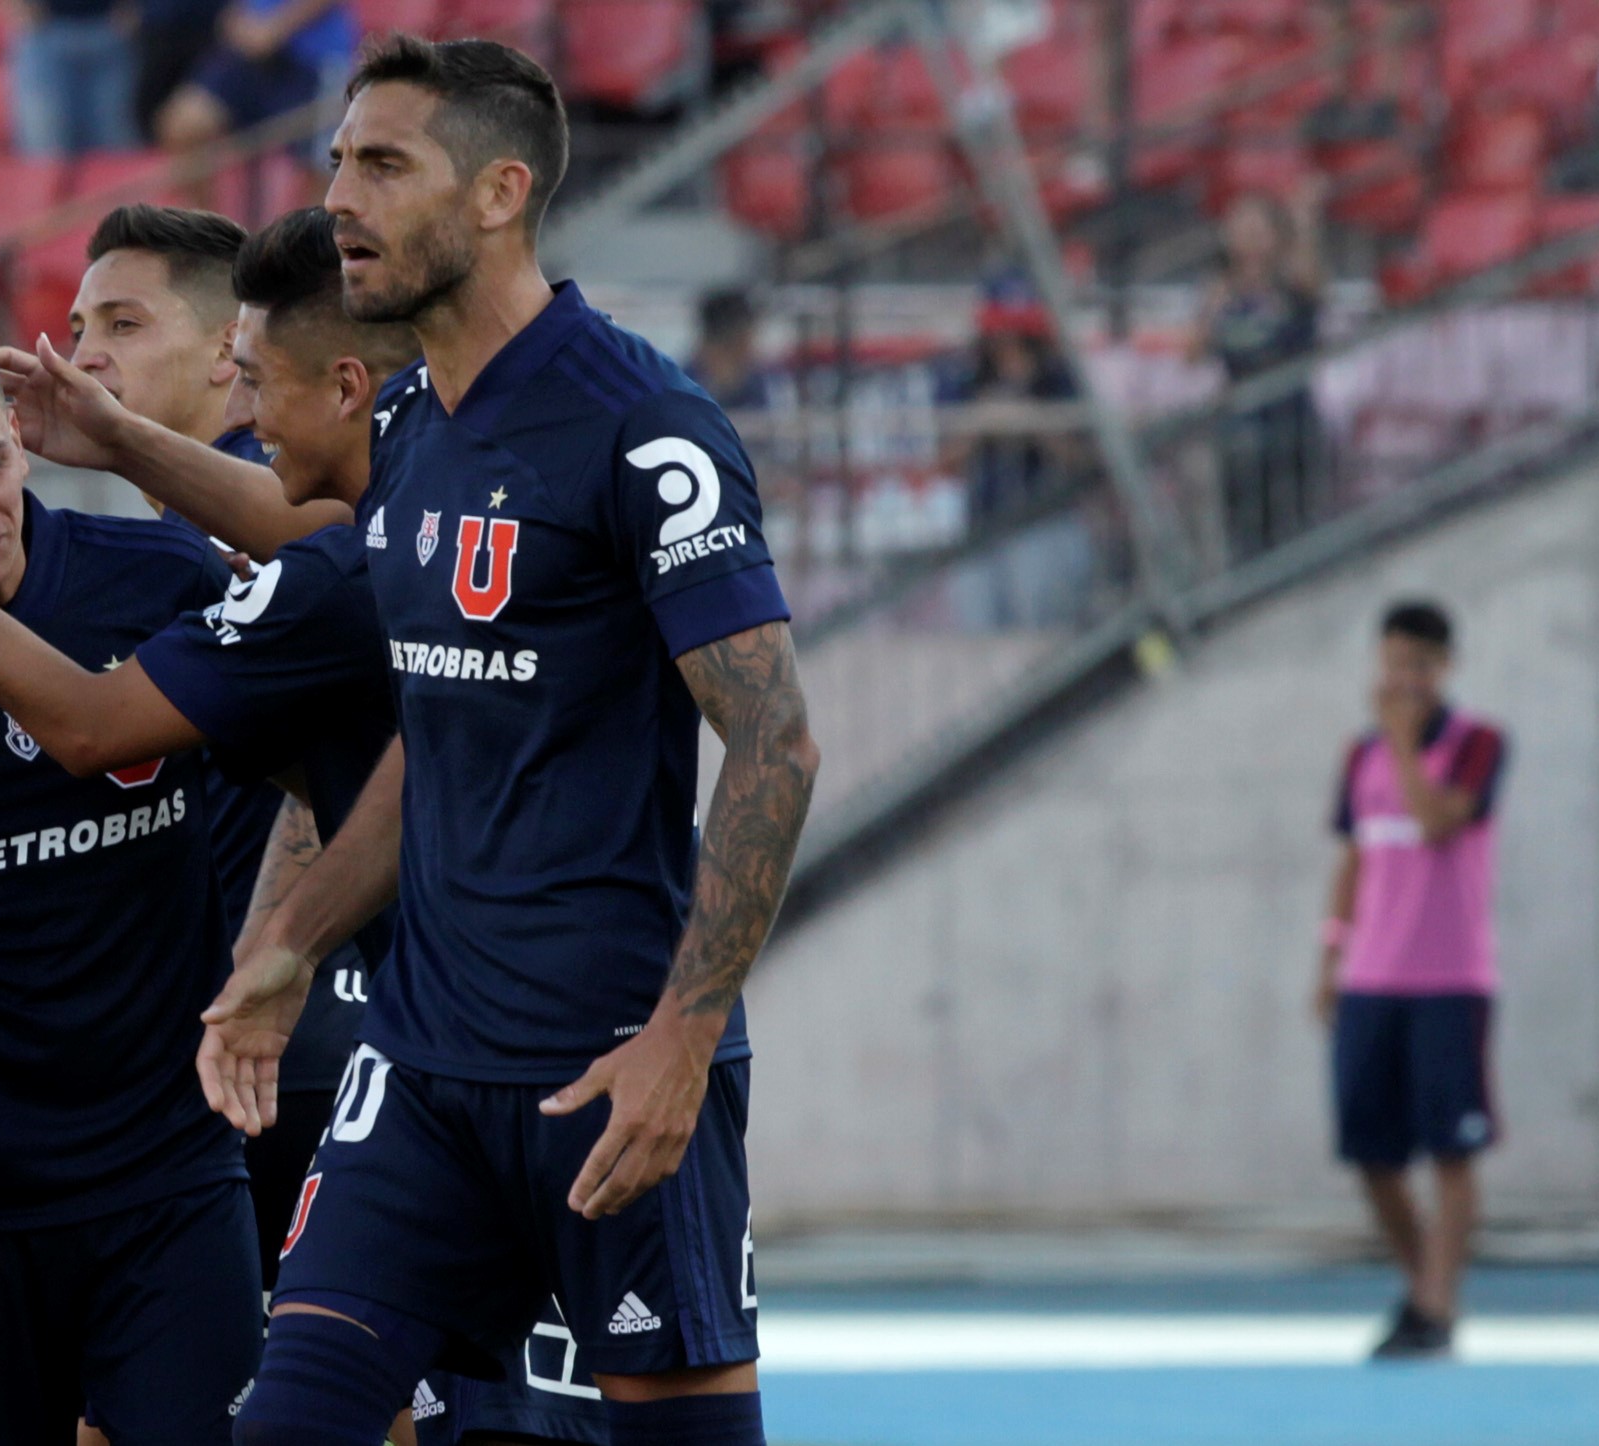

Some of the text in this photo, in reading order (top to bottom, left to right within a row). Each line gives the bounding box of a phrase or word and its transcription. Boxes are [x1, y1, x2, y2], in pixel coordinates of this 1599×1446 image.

[452, 515, 519, 622] U
[650, 524, 746, 574] DIRECTV
[318, 1042, 393, 1142] 0
[608, 1315, 662, 1335] adidas
